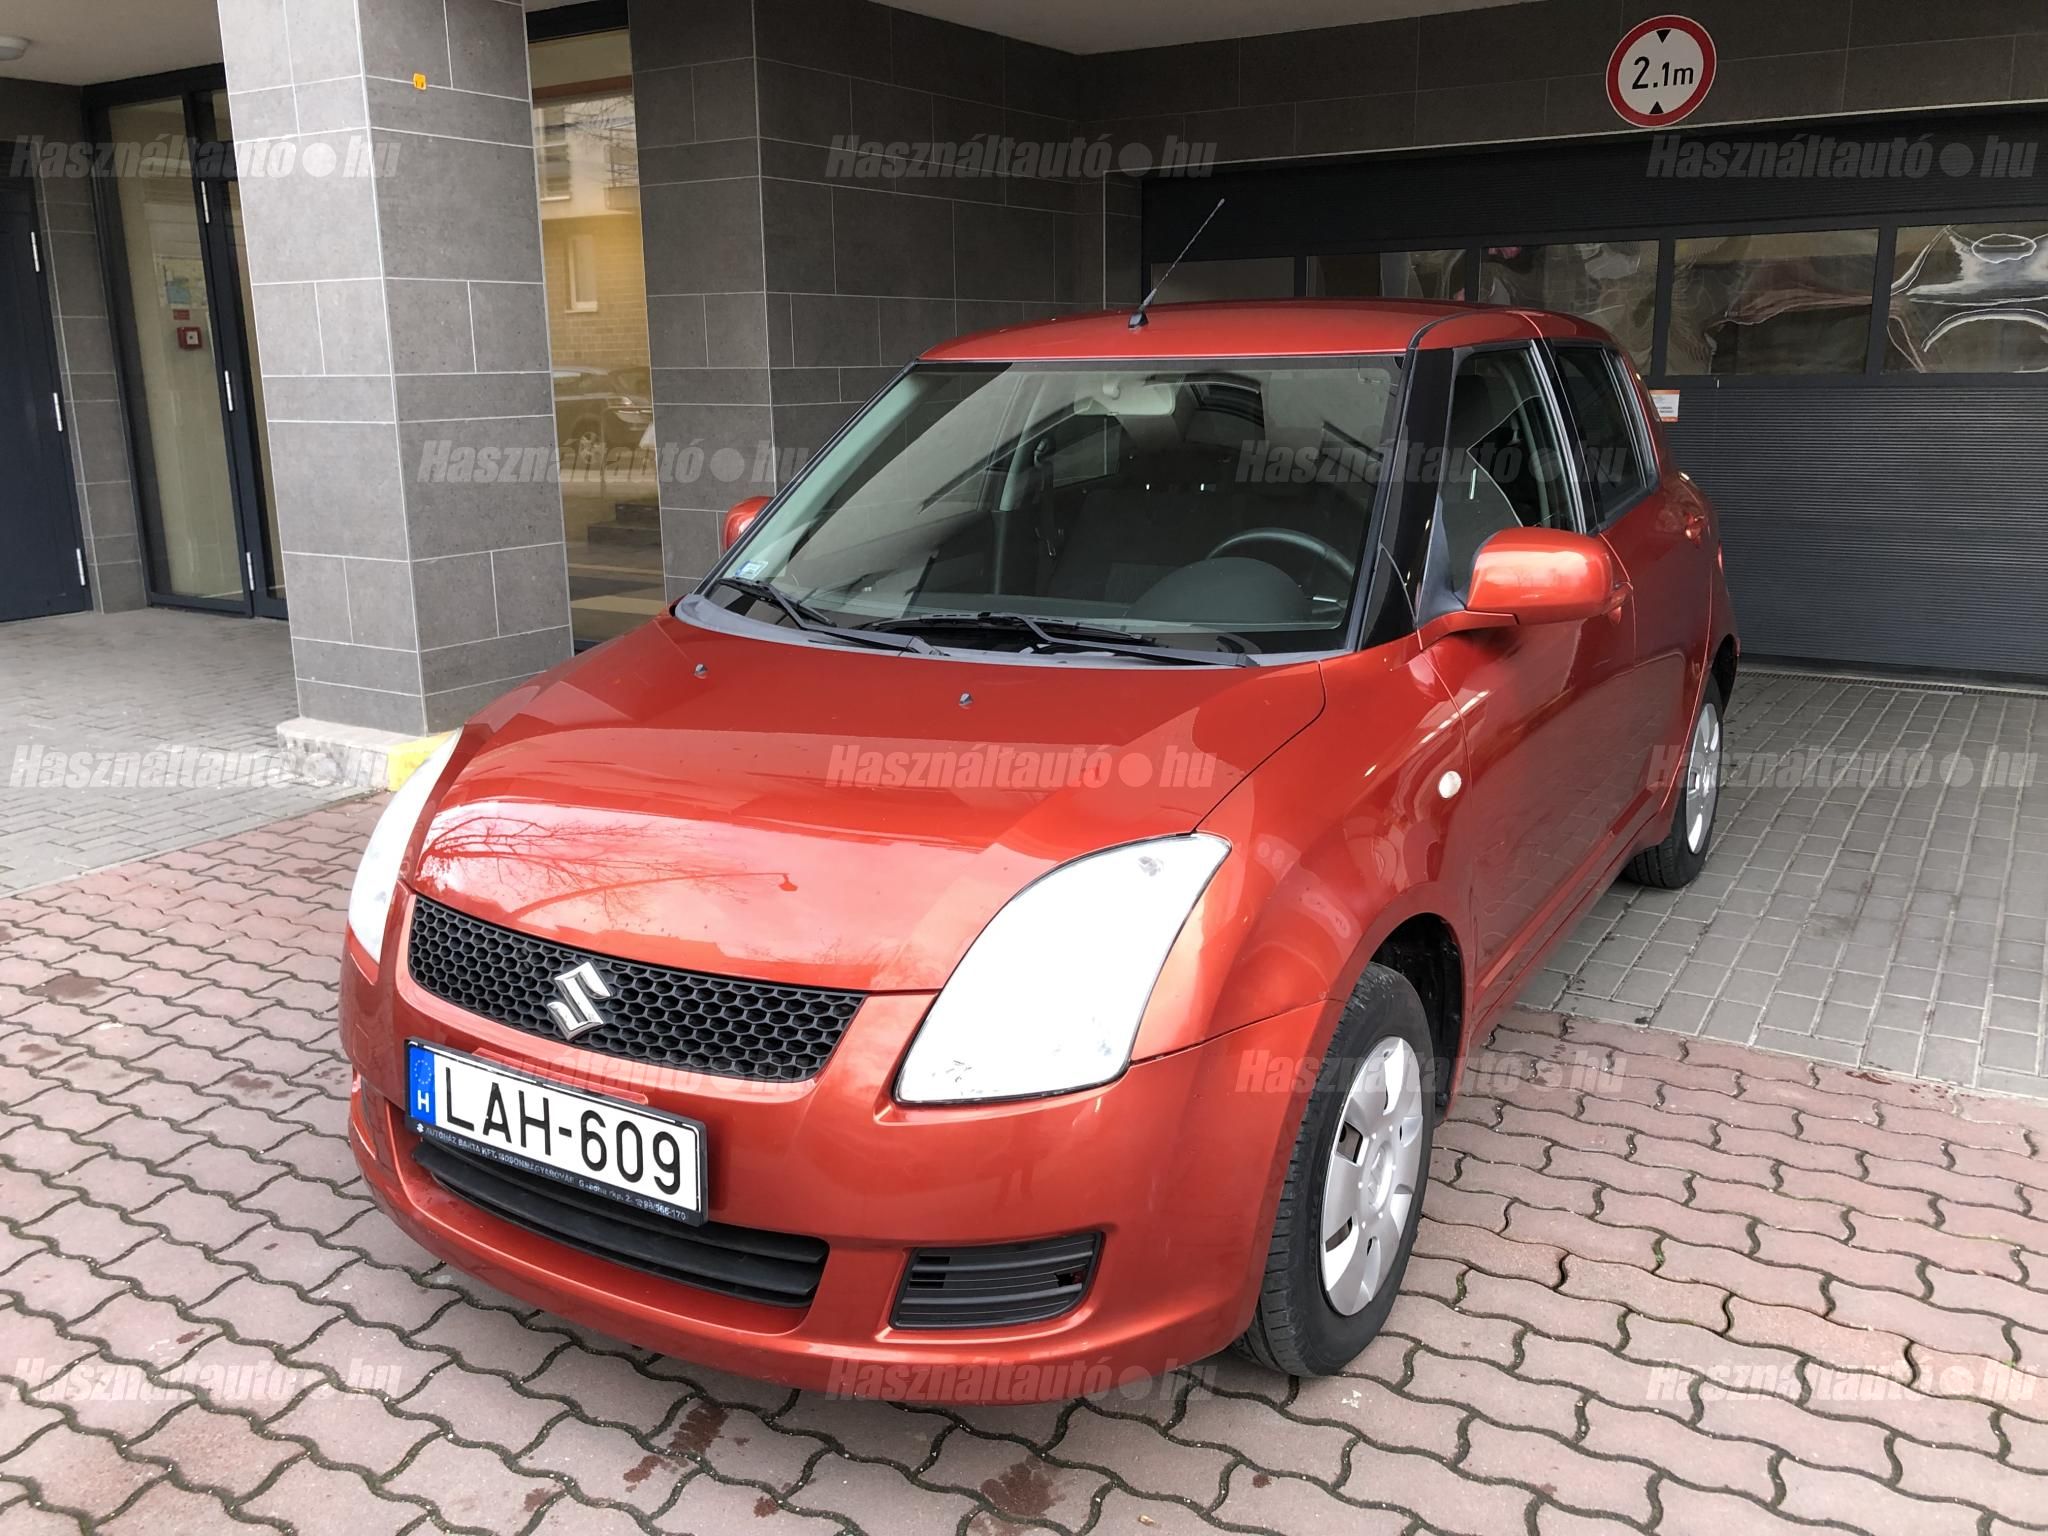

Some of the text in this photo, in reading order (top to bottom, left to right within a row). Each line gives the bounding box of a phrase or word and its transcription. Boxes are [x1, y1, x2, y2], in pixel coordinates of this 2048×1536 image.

[1631, 55, 1694, 90] 2.1m
[417, 1090, 430, 1113] H
[445, 1067, 681, 1195] LAH-609
